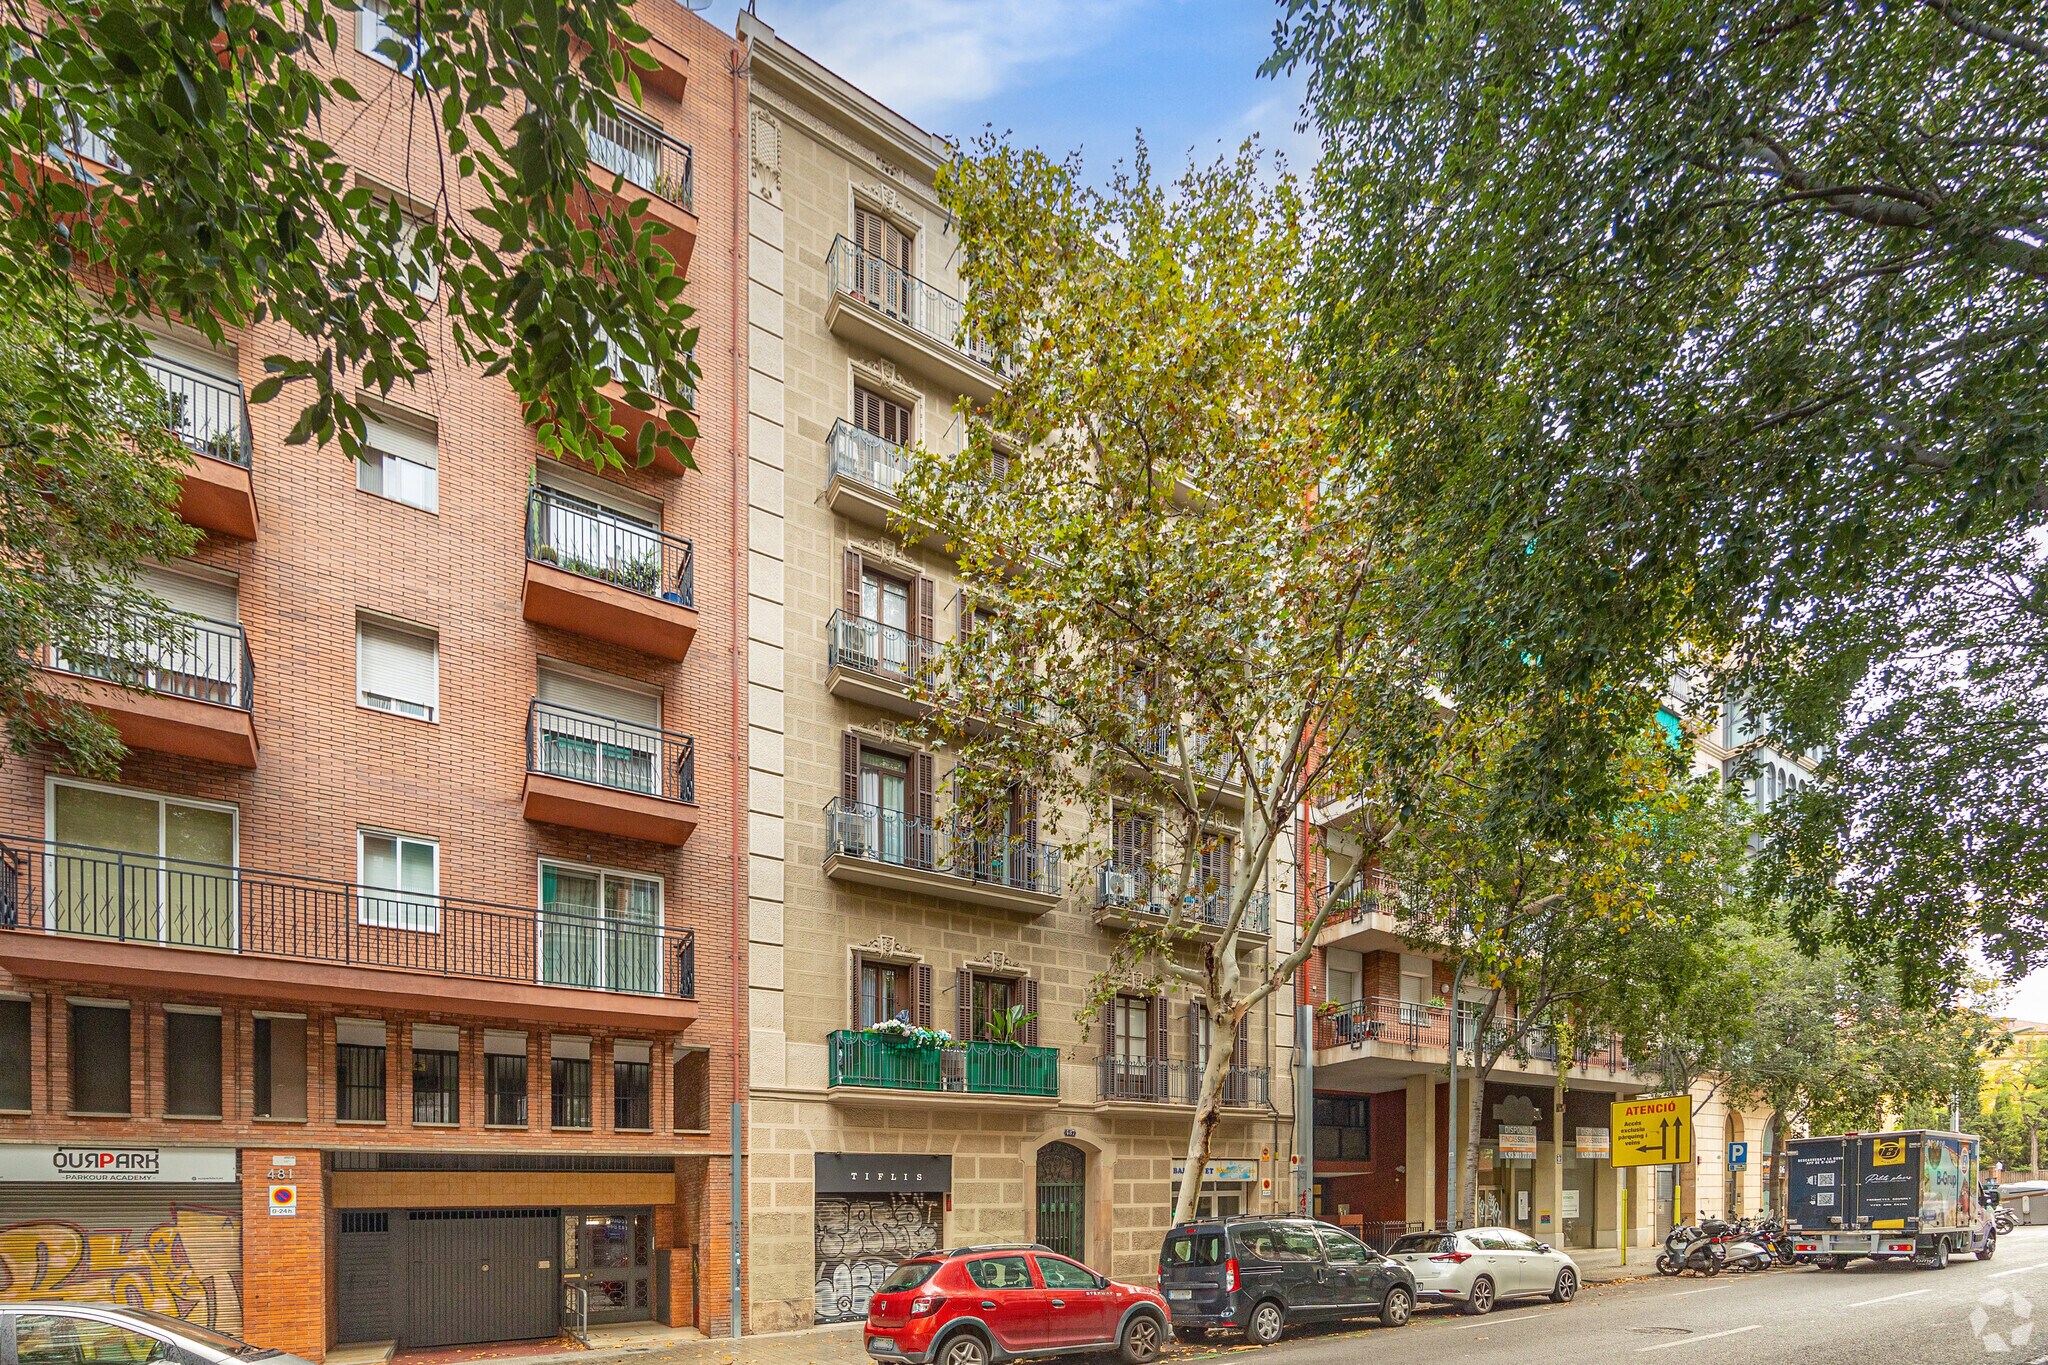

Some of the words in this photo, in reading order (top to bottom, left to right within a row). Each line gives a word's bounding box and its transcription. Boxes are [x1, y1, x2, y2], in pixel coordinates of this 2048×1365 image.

[1625, 1101, 1676, 1116] ATENCIÓ
[1504, 1126, 1533, 1135] DISPONIBLE
[1733, 1144, 1744, 1161] P
[267, 1168, 293, 1180] 481
[851, 1172, 923, 1181] TIFLIS
